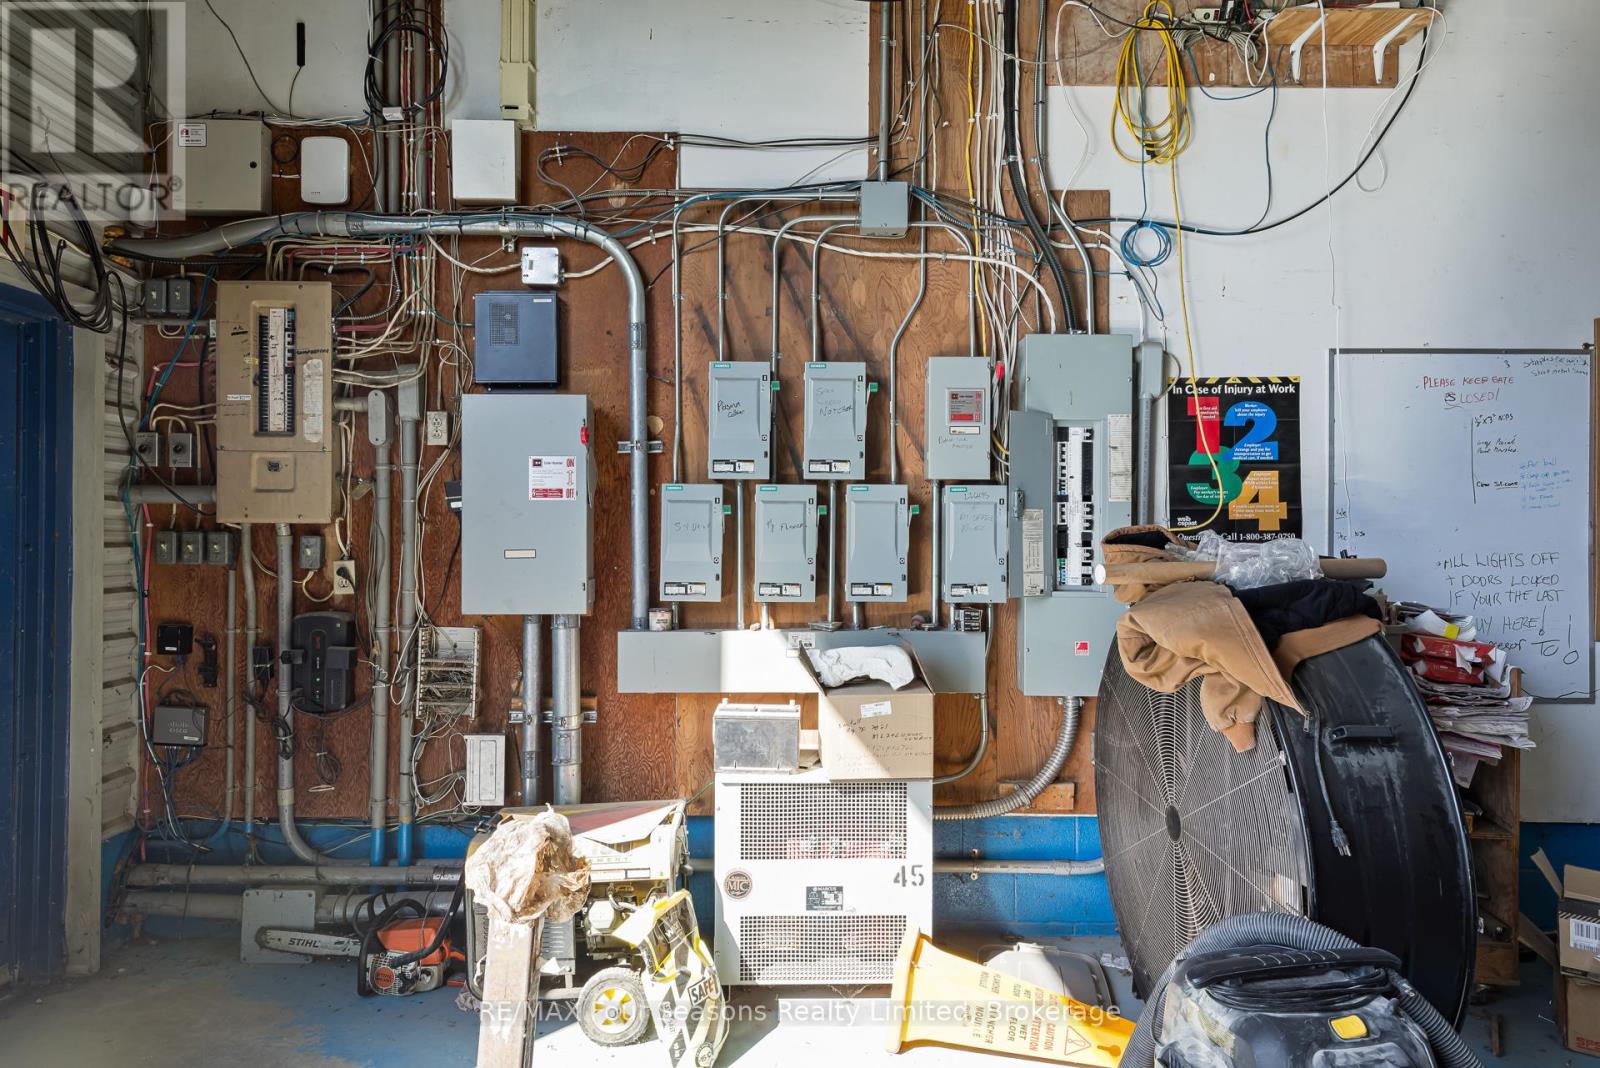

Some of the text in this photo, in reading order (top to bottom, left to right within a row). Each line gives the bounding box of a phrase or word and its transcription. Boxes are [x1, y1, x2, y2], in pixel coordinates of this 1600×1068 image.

[1172, 383, 1296, 397] In Cse of Injury at Work
[1423, 375, 1456, 390] PLEASE
[1462, 376, 1489, 385] KEEP
[1223, 401, 1279, 461] 2
[1229, 471, 1288, 531] 4
[1221, 532, 1237, 540] Call
[1476, 552, 1525, 568] LIGHTS
[1530, 552, 1560, 565] OFF
[1461, 574, 1503, 588] DOORS
[1511, 574, 1559, 587] LOCKED
[1449, 589, 1564, 610] IF YOUR THE LAST
[1475, 605, 1546, 636] UY HERE!
[893, 865, 925, 887] 45
[288, 937, 321, 949] STIHL
[1007, 1016, 1018, 1042] FLOOR
[1019, 1024, 1028, 1041] WET
